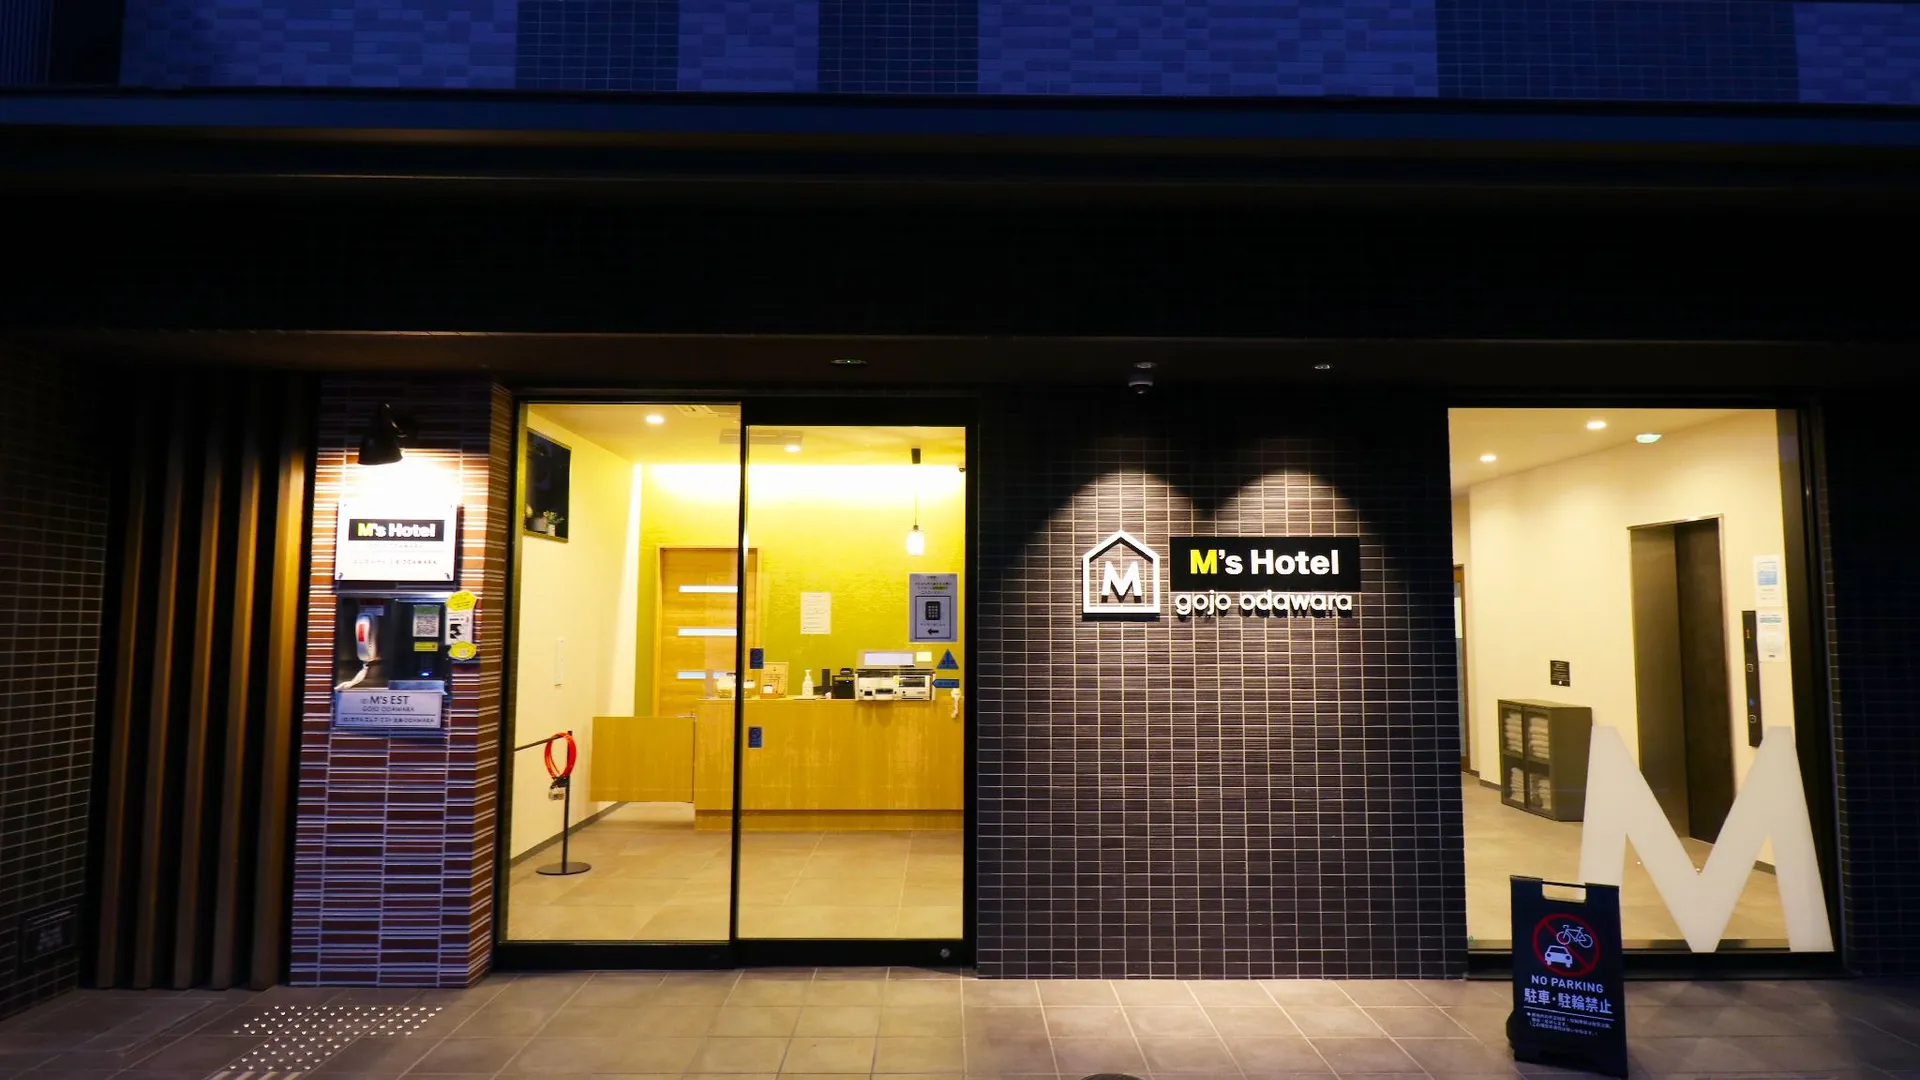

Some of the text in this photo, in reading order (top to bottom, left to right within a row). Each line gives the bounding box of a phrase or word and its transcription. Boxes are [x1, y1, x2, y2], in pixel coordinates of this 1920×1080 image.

[357, 522, 436, 538] M's Hotel
[1190, 549, 1339, 575] M’s Hotel
[1101, 560, 1143, 598] M
[1175, 590, 1353, 616] gojo odawara
[370, 695, 411, 705] M's EST
[1531, 974, 1604, 993] NO PARKING
[1524, 987, 1613, 1014] 駐車・駐輪禁止
